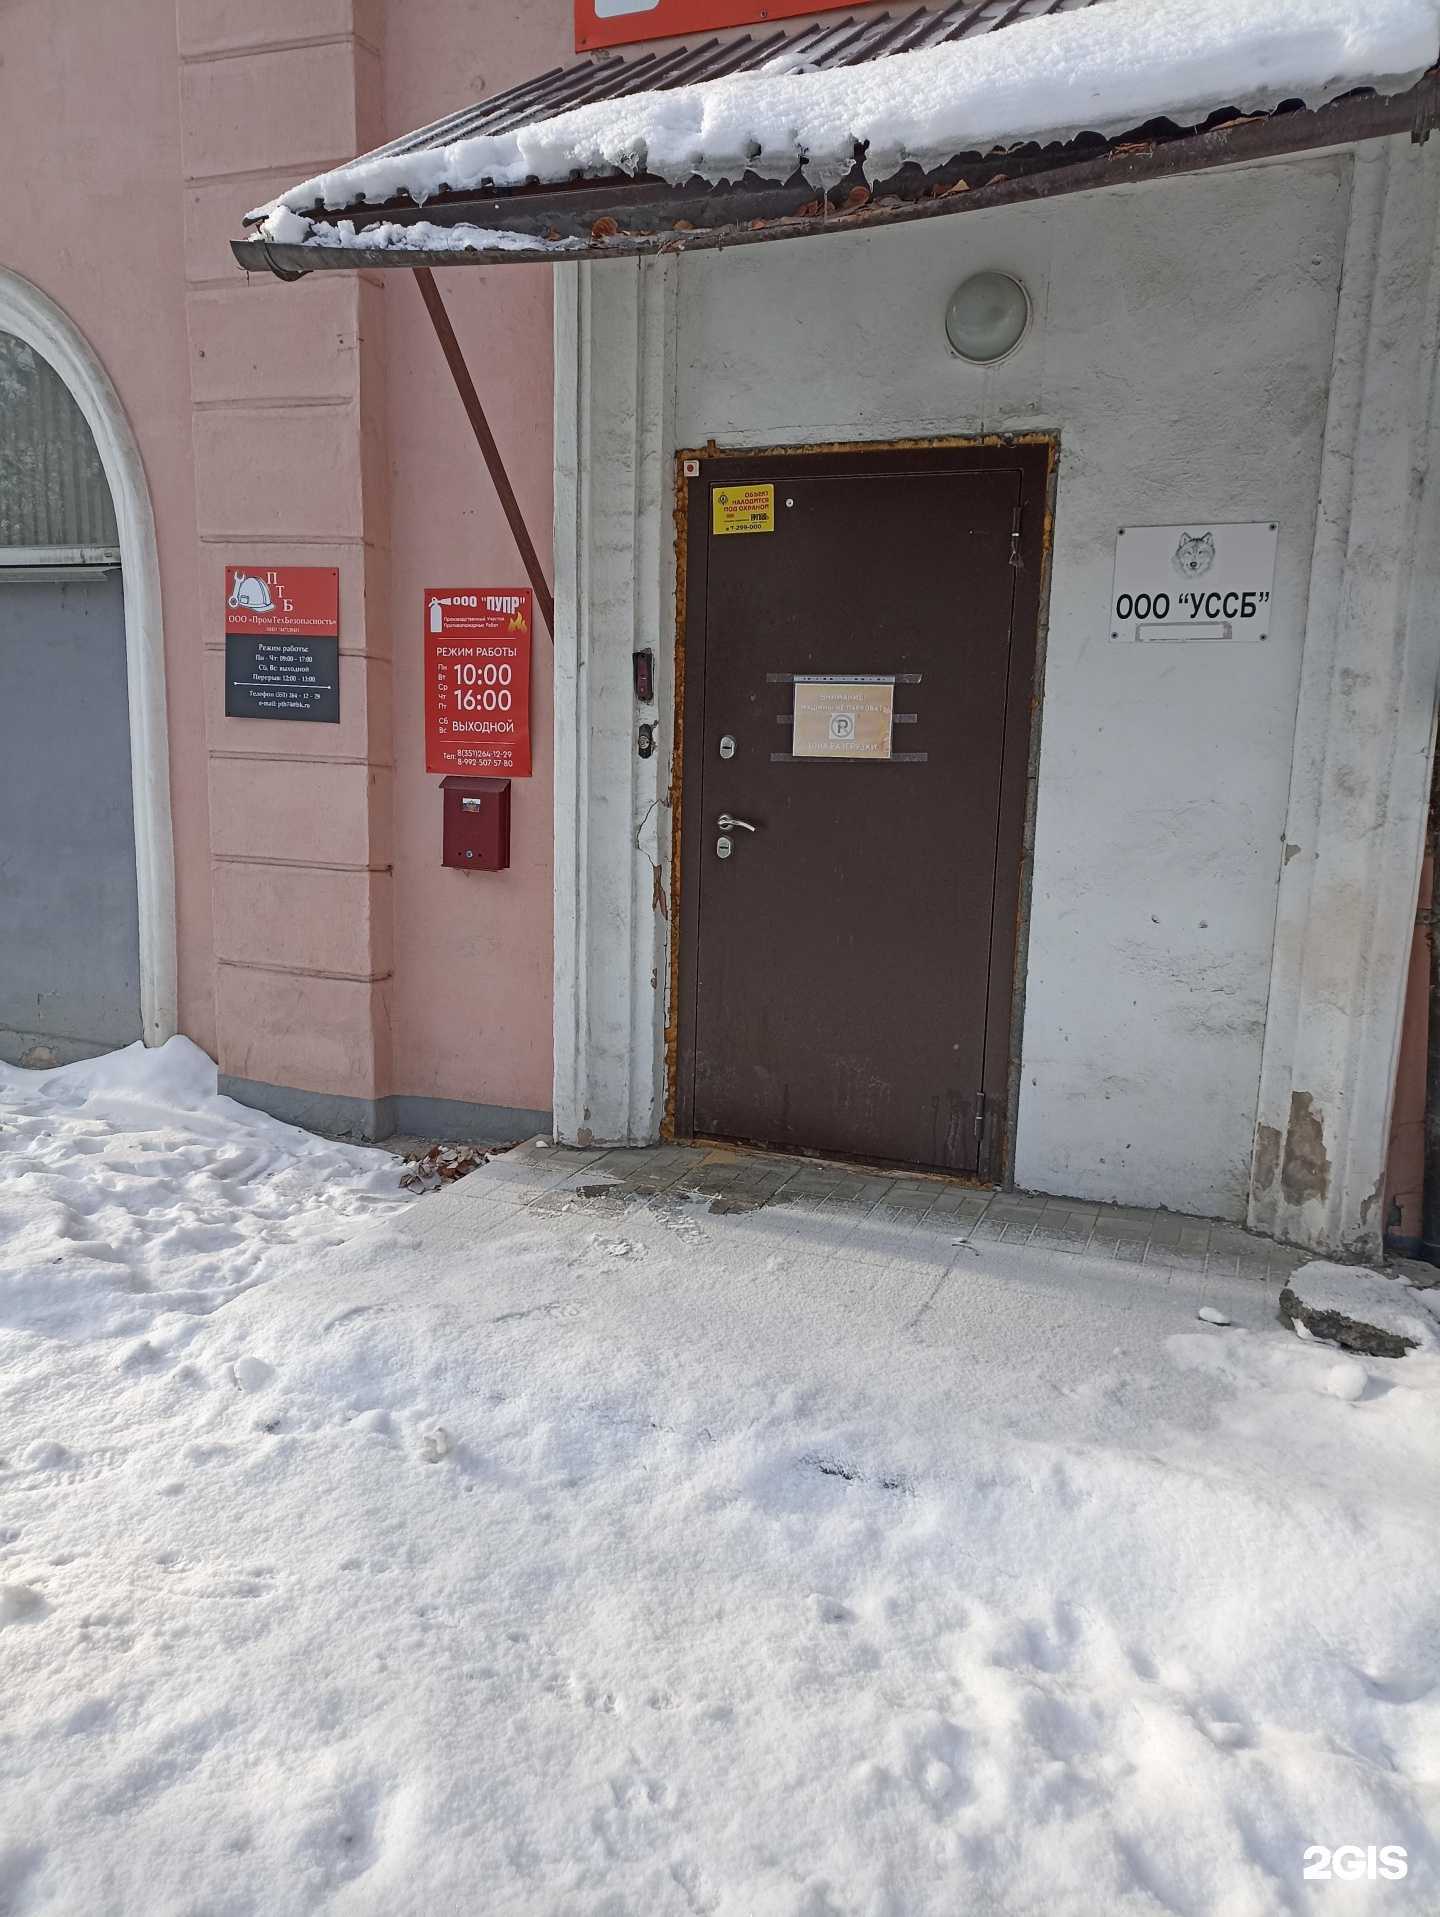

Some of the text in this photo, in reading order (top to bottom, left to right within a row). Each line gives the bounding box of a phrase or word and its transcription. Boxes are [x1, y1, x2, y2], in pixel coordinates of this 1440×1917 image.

[266, 571, 278, 585] П
[275, 585, 285, 598] Т
[283, 599, 294, 612] Б
[452, 595, 478, 607] ООО
[1116, 593, 1170, 619] ООО
[436, 647, 517, 657] РЕЖИМ РАБОТЫ
[453, 663, 512, 686] 10:00
[438, 683, 448, 691] Ср
[438, 702, 447, 710] Пт
[453, 689, 512, 711] 16:00
[438, 717, 449, 725] Сб
[452, 719, 514, 733] ВЫХОДНОЙ
